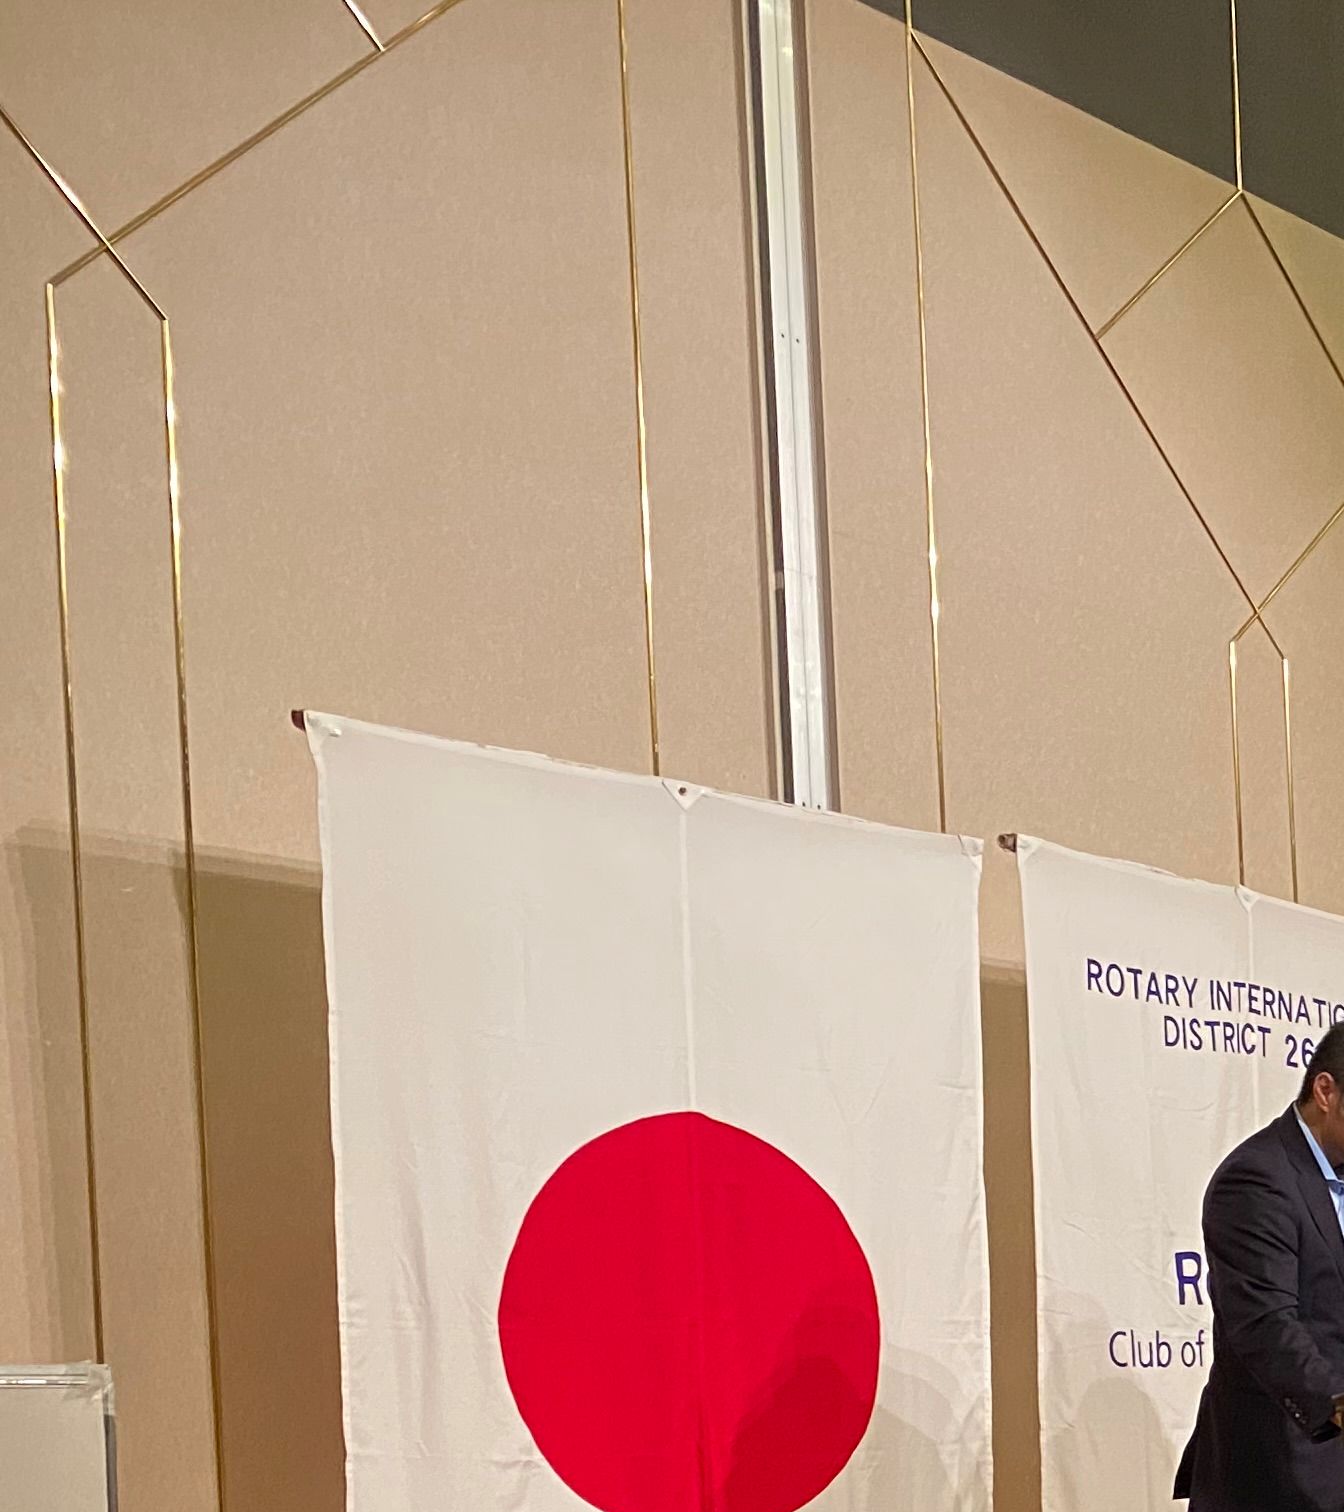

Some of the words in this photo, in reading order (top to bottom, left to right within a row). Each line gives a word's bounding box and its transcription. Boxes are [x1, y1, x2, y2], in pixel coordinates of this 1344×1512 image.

[1086, 958, 1198, 1008] ROTARY
[1163, 1015, 1271, 1057] DISTRICT
[1109, 1329, 1172, 1368] Club
[1181, 1329, 1205, 1367] of
